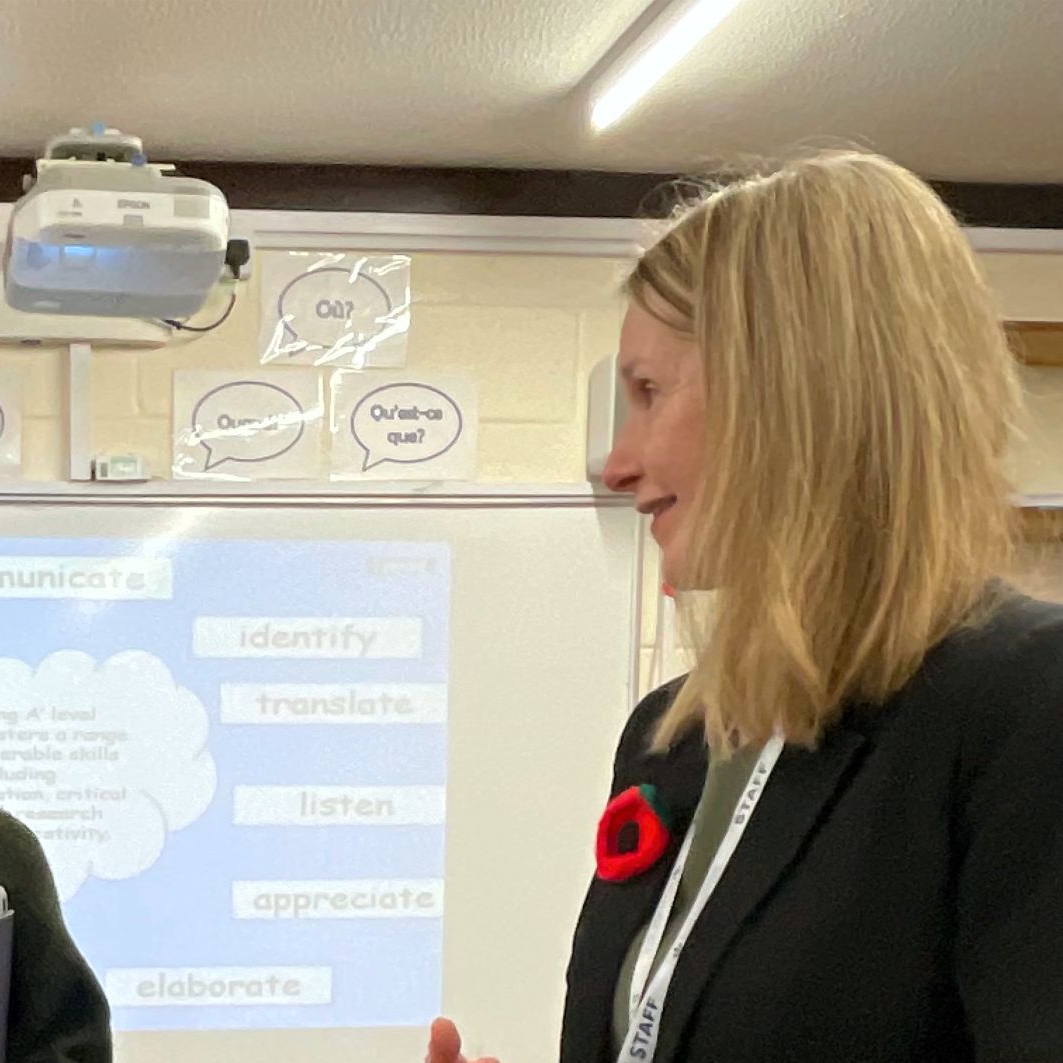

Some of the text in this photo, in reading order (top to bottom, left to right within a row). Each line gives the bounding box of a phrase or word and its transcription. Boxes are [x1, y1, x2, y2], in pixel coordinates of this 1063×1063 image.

[370, 404, 443, 422] Qu'est-ce
[387, 428, 425, 446] que?
[240, 622, 378, 657] identify
[52, 707, 97, 721] level
[256, 689, 412, 715] translate
[56, 730, 67, 741] a
[72, 729, 128, 746] range
[69, 746, 119, 761] skills
[56, 787, 126, 801] critical
[299, 792, 394, 817] listen
[734, 762, 768, 825] STAFF
[253, 888, 435, 918] appreciate
[137, 971, 301, 998] elaborate
[629, 996, 659, 1060] STAFF
